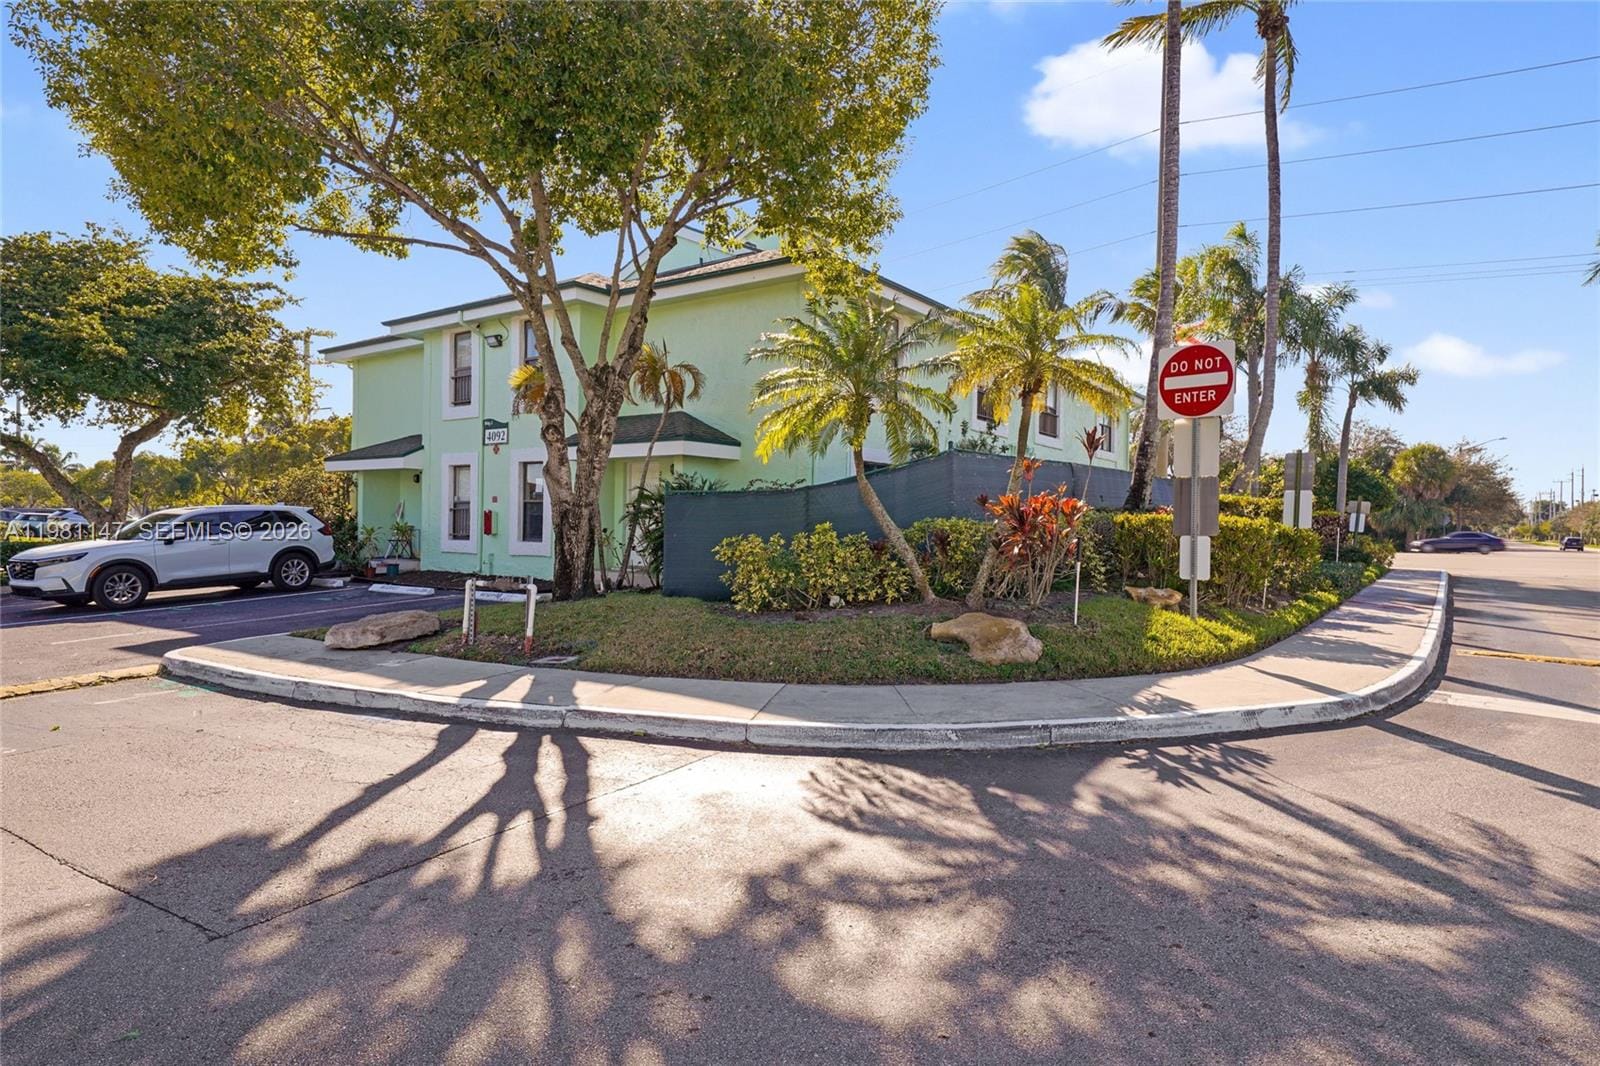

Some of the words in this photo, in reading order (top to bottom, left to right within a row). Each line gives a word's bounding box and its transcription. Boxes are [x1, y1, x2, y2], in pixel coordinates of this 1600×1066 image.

[1170, 361, 1188, 373] DO
[1194, 357, 1222, 370] NOT
[1174, 390, 1216, 404] ENTER
[486, 430, 505, 441] 4092
